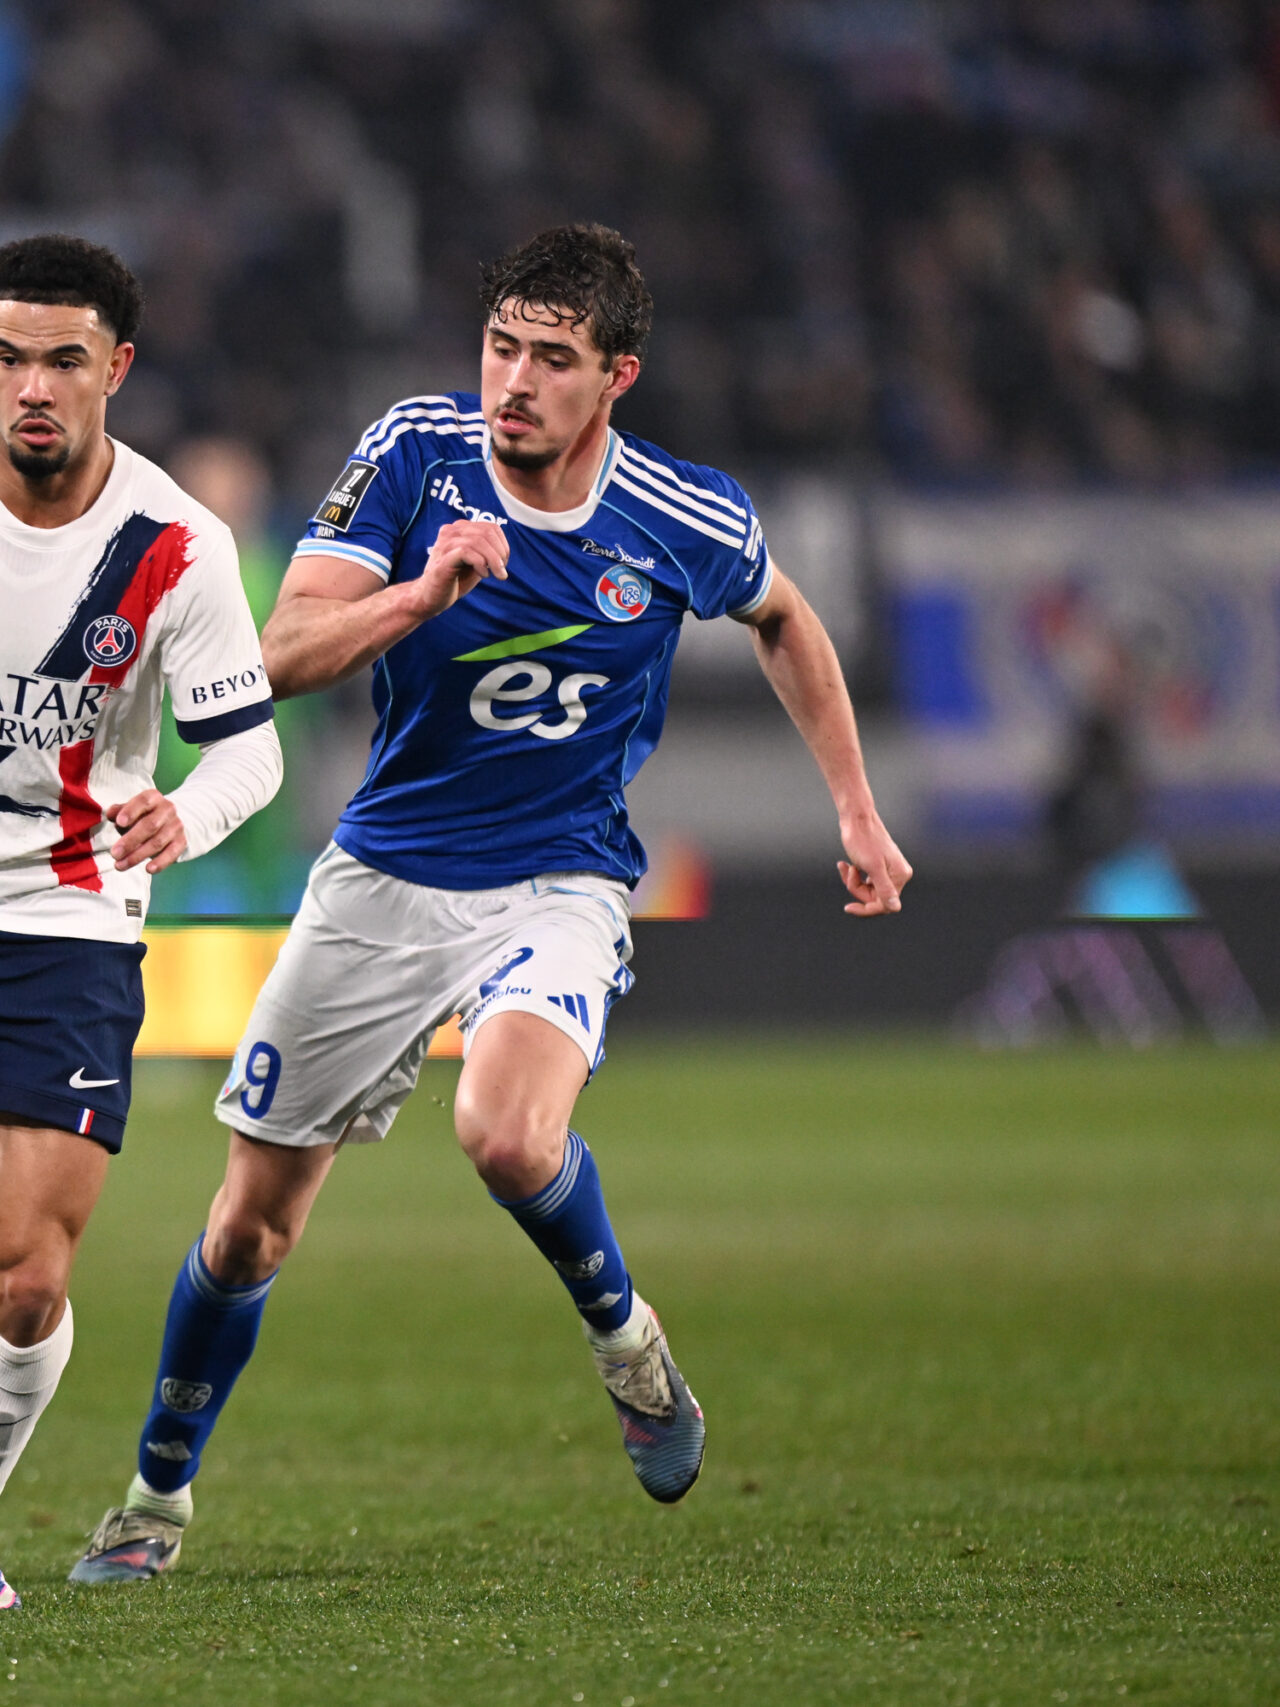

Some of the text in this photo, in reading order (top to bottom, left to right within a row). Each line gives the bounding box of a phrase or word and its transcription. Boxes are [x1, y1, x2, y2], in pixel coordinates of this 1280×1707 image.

[94, 617, 130, 634] PARIS
[469, 661, 611, 740] es
[240, 1041, 282, 1120] 9
